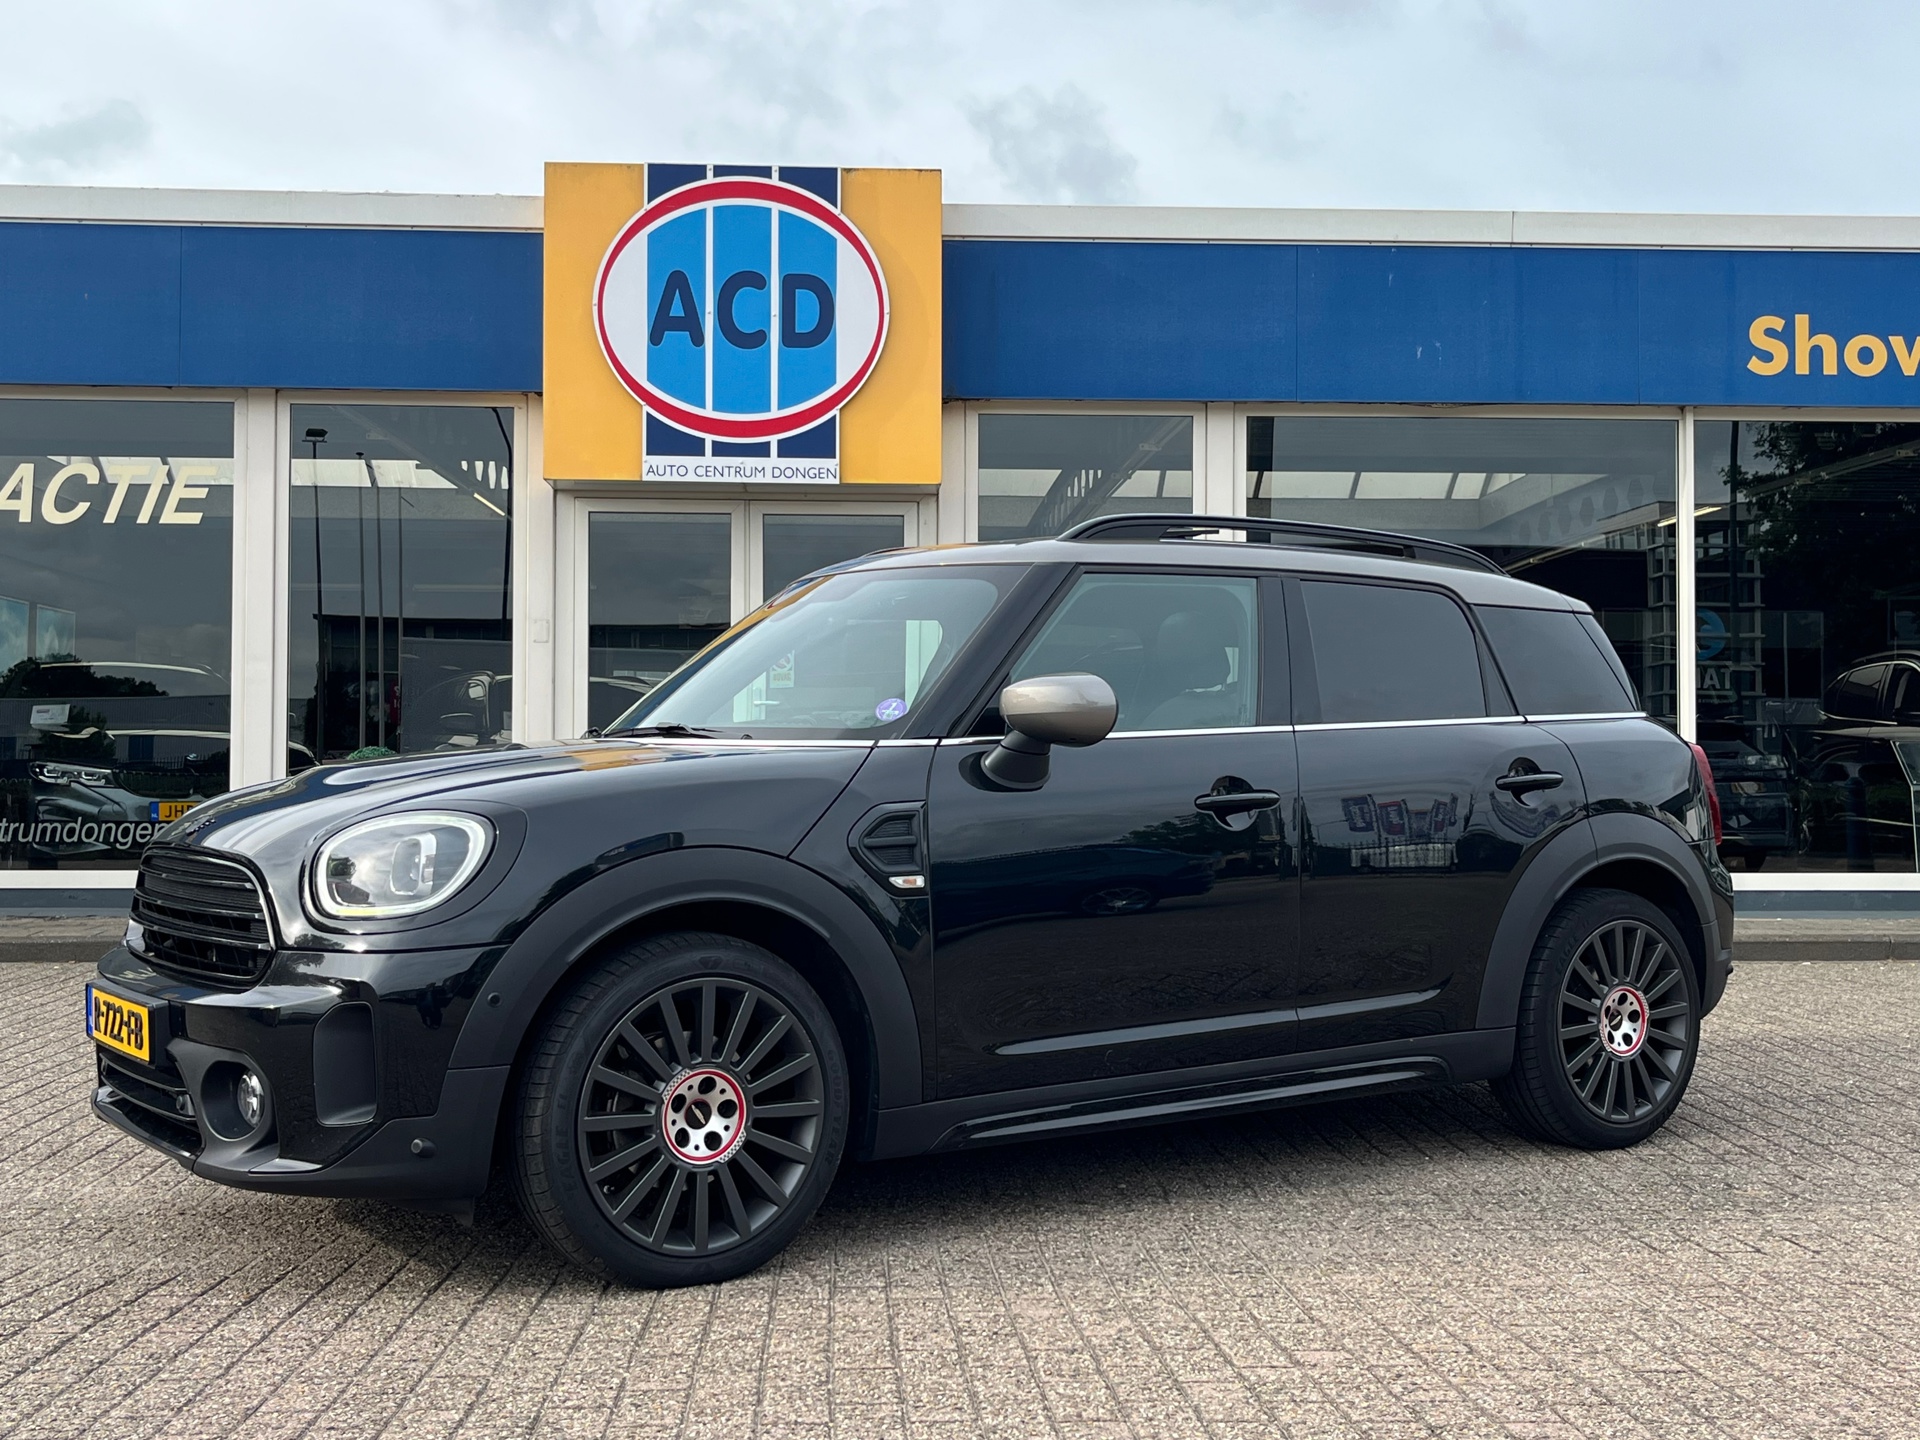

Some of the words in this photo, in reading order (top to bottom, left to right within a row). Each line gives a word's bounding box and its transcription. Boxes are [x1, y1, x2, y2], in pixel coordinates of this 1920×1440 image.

[650, 270, 835, 349] ACD
[0, 463, 218, 524] ACTIE
[646, 464, 688, 477] AUTO
[694, 465, 766, 478] CENTRUM
[772, 467, 837, 479] DONGEN
